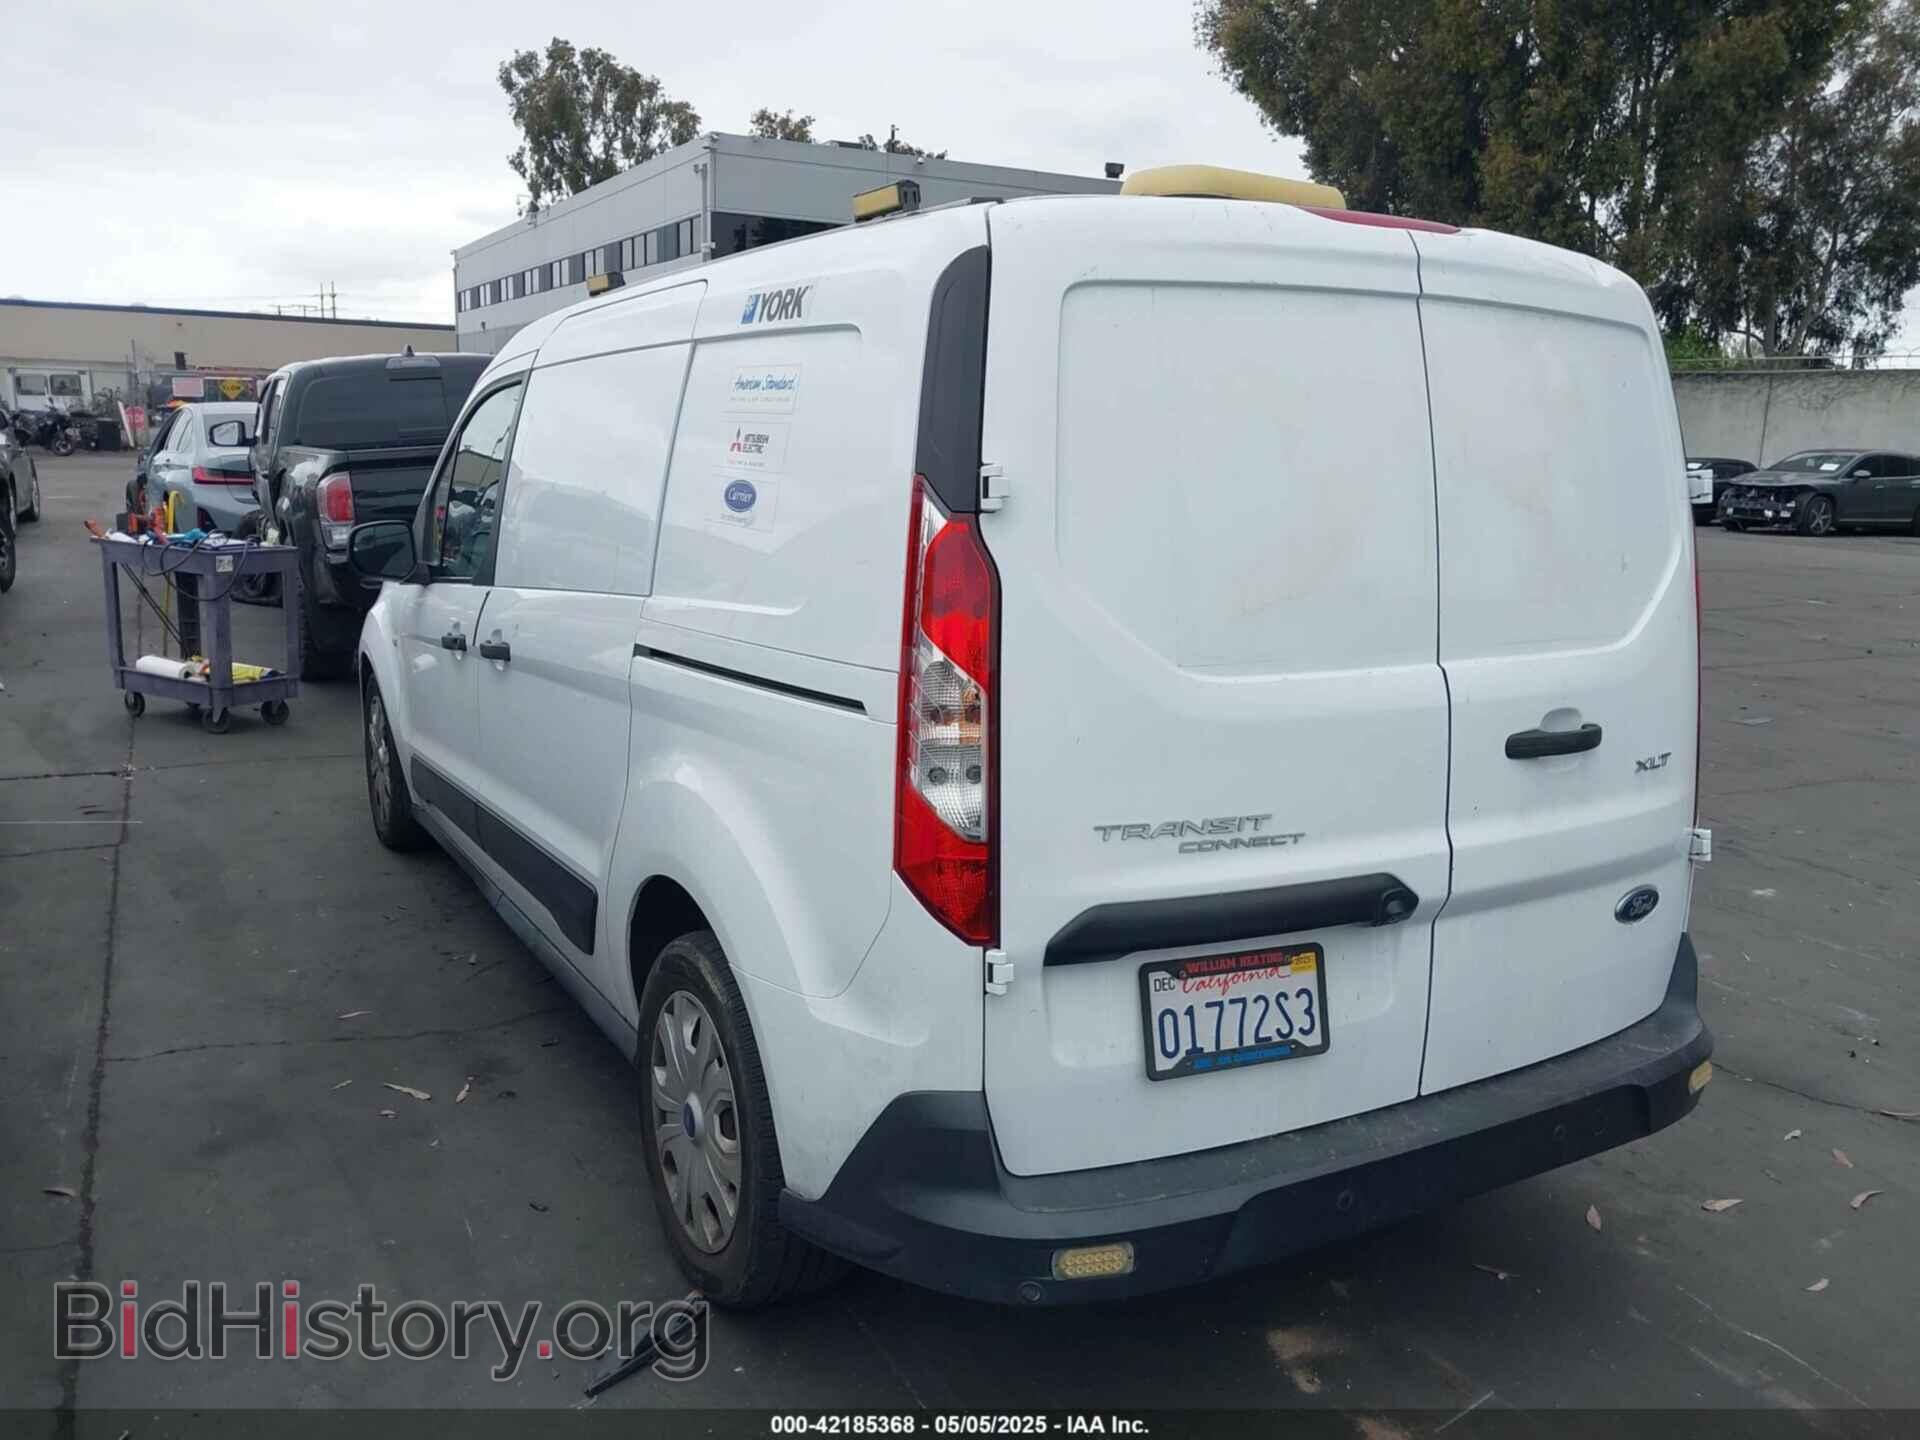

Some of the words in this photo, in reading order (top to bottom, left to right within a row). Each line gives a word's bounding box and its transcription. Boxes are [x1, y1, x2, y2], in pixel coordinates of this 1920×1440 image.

[758, 285, 809, 323] YORK
[1634, 752, 1672, 774] XLT
[1093, 814, 1273, 842] TRANSIT
[1178, 832, 1306, 854] CONNECT
[1154, 976, 1175, 992] DEC
[1158, 988, 1316, 1058] 01772S3
